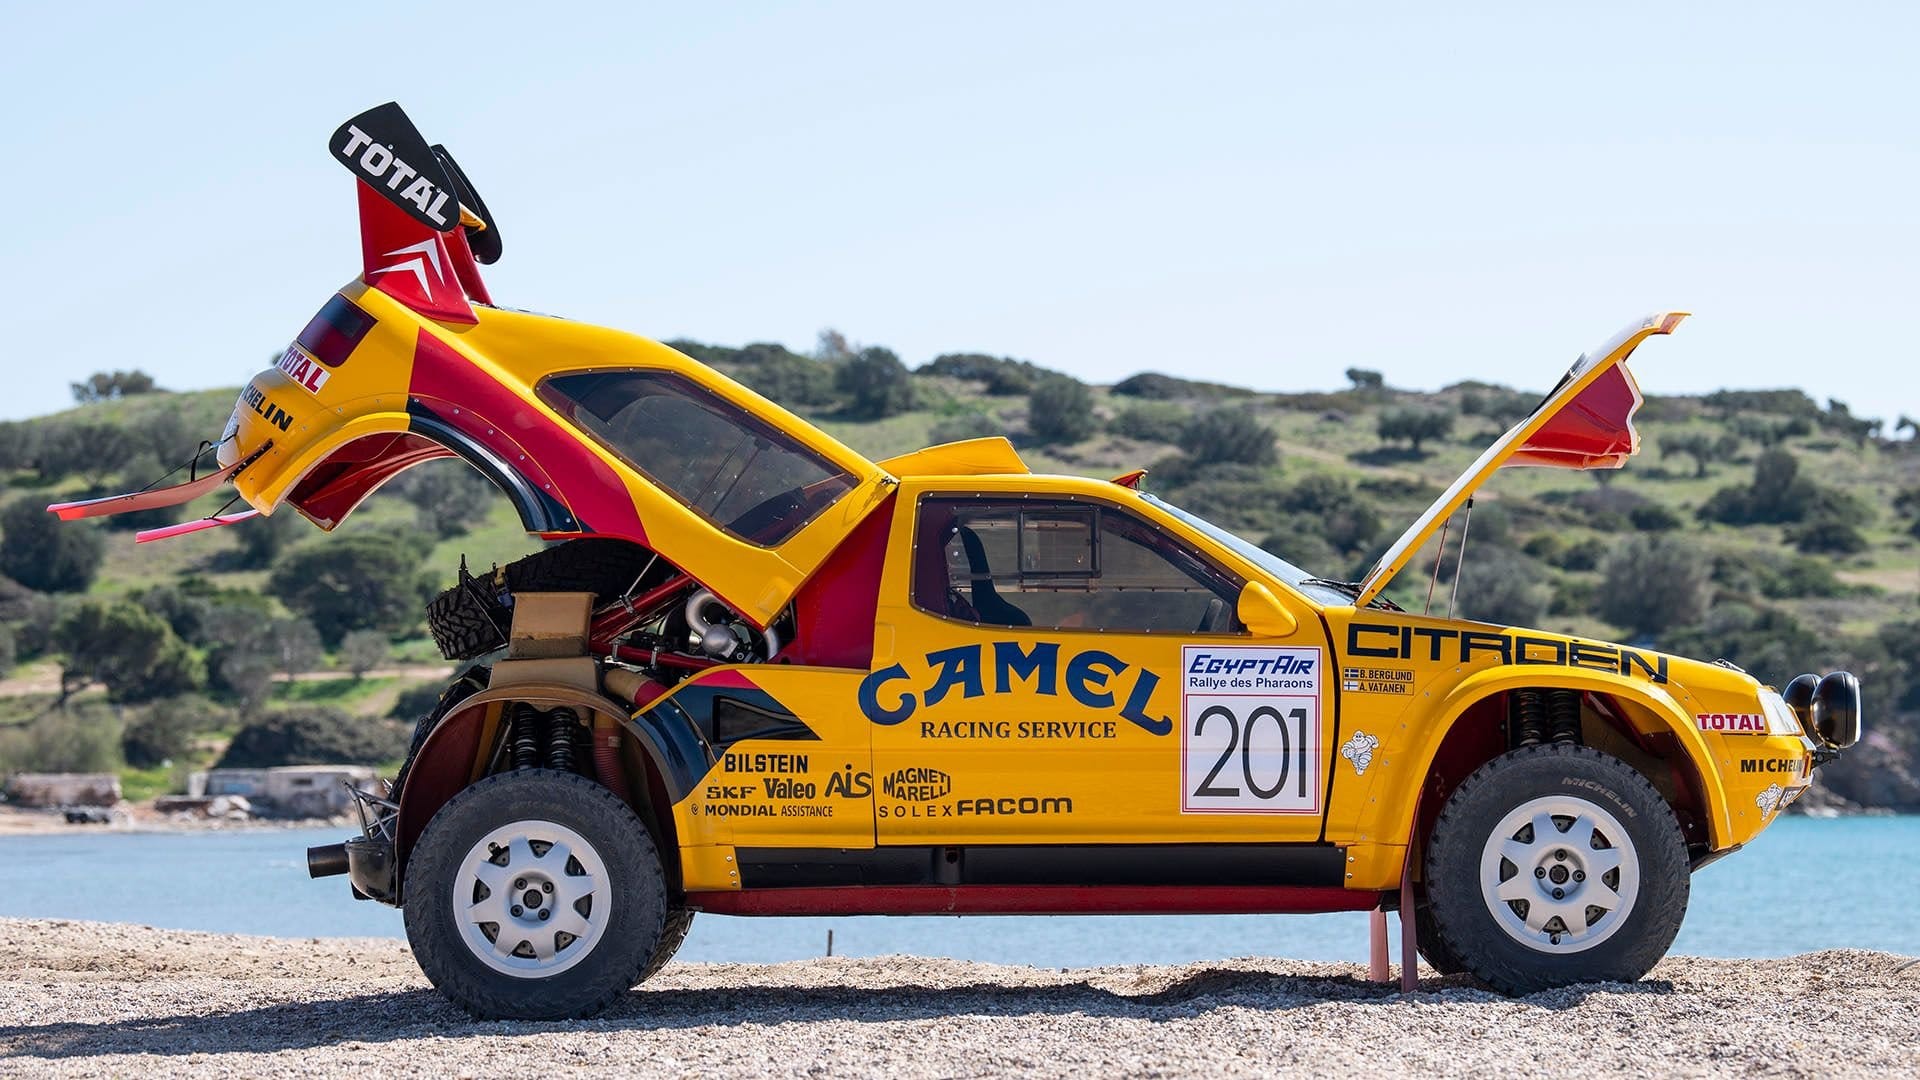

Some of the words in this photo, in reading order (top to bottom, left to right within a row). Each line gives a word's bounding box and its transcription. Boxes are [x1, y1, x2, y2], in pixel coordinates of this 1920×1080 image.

[342, 124, 450, 226] TOTAL
[280, 345, 324, 394] TOTAL
[1189, 677, 1227, 688] Rallye
[1230, 677, 1252, 688] des
[1255, 677, 1314, 689] Pharaons
[1368, 669, 1412, 681] BERGLUND
[857, 641, 1174, 737] CAMEL
[1368, 682, 1406, 693] VATANEN
[920, 721, 1011, 739] RACING
[1017, 721, 1117, 739] SERVICE
[1697, 714, 1765, 731] TOTAL
[1193, 705, 1307, 800] 201
[724, 753, 809, 774] BILSTEIN
[883, 767, 951, 786] MAGNETI
[706, 786, 757, 800] SKF
[763, 778, 817, 800] Valeo
[883, 782, 951, 802] MARELLI
[1561, 777, 1638, 818] MICHELIN
[704, 804, 777, 817] MONDIAL
[780, 805, 833, 818] ASSISTANCE
